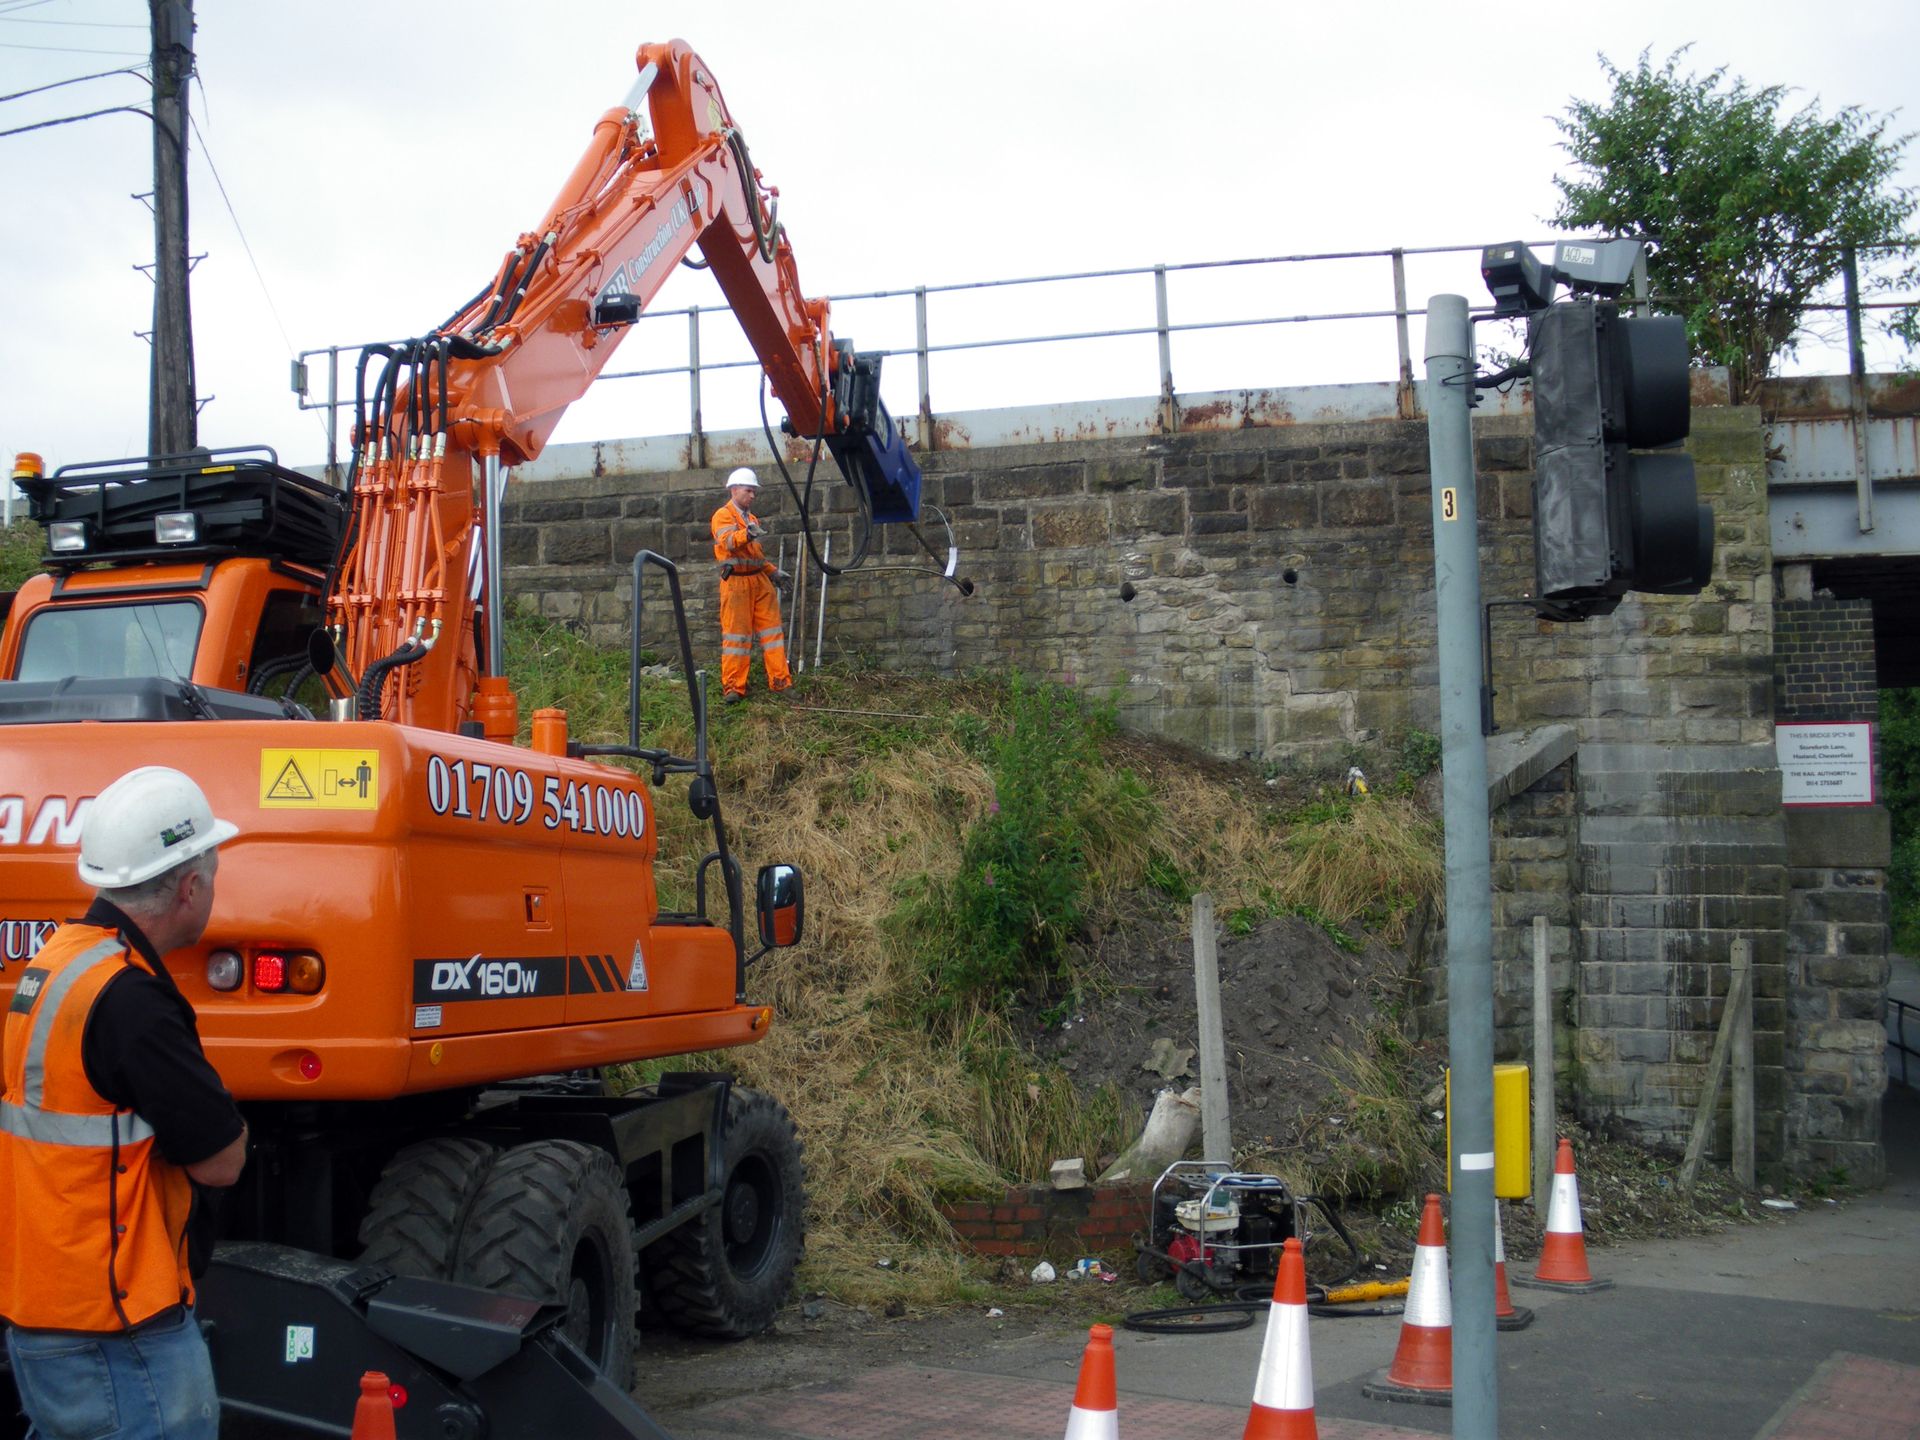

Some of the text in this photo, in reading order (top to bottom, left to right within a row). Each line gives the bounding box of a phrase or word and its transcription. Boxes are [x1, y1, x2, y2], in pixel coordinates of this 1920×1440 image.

[628, 221, 671, 284] Construction
[1443, 490, 1454, 518] 3
[427, 755, 645, 839] 01709 541000
